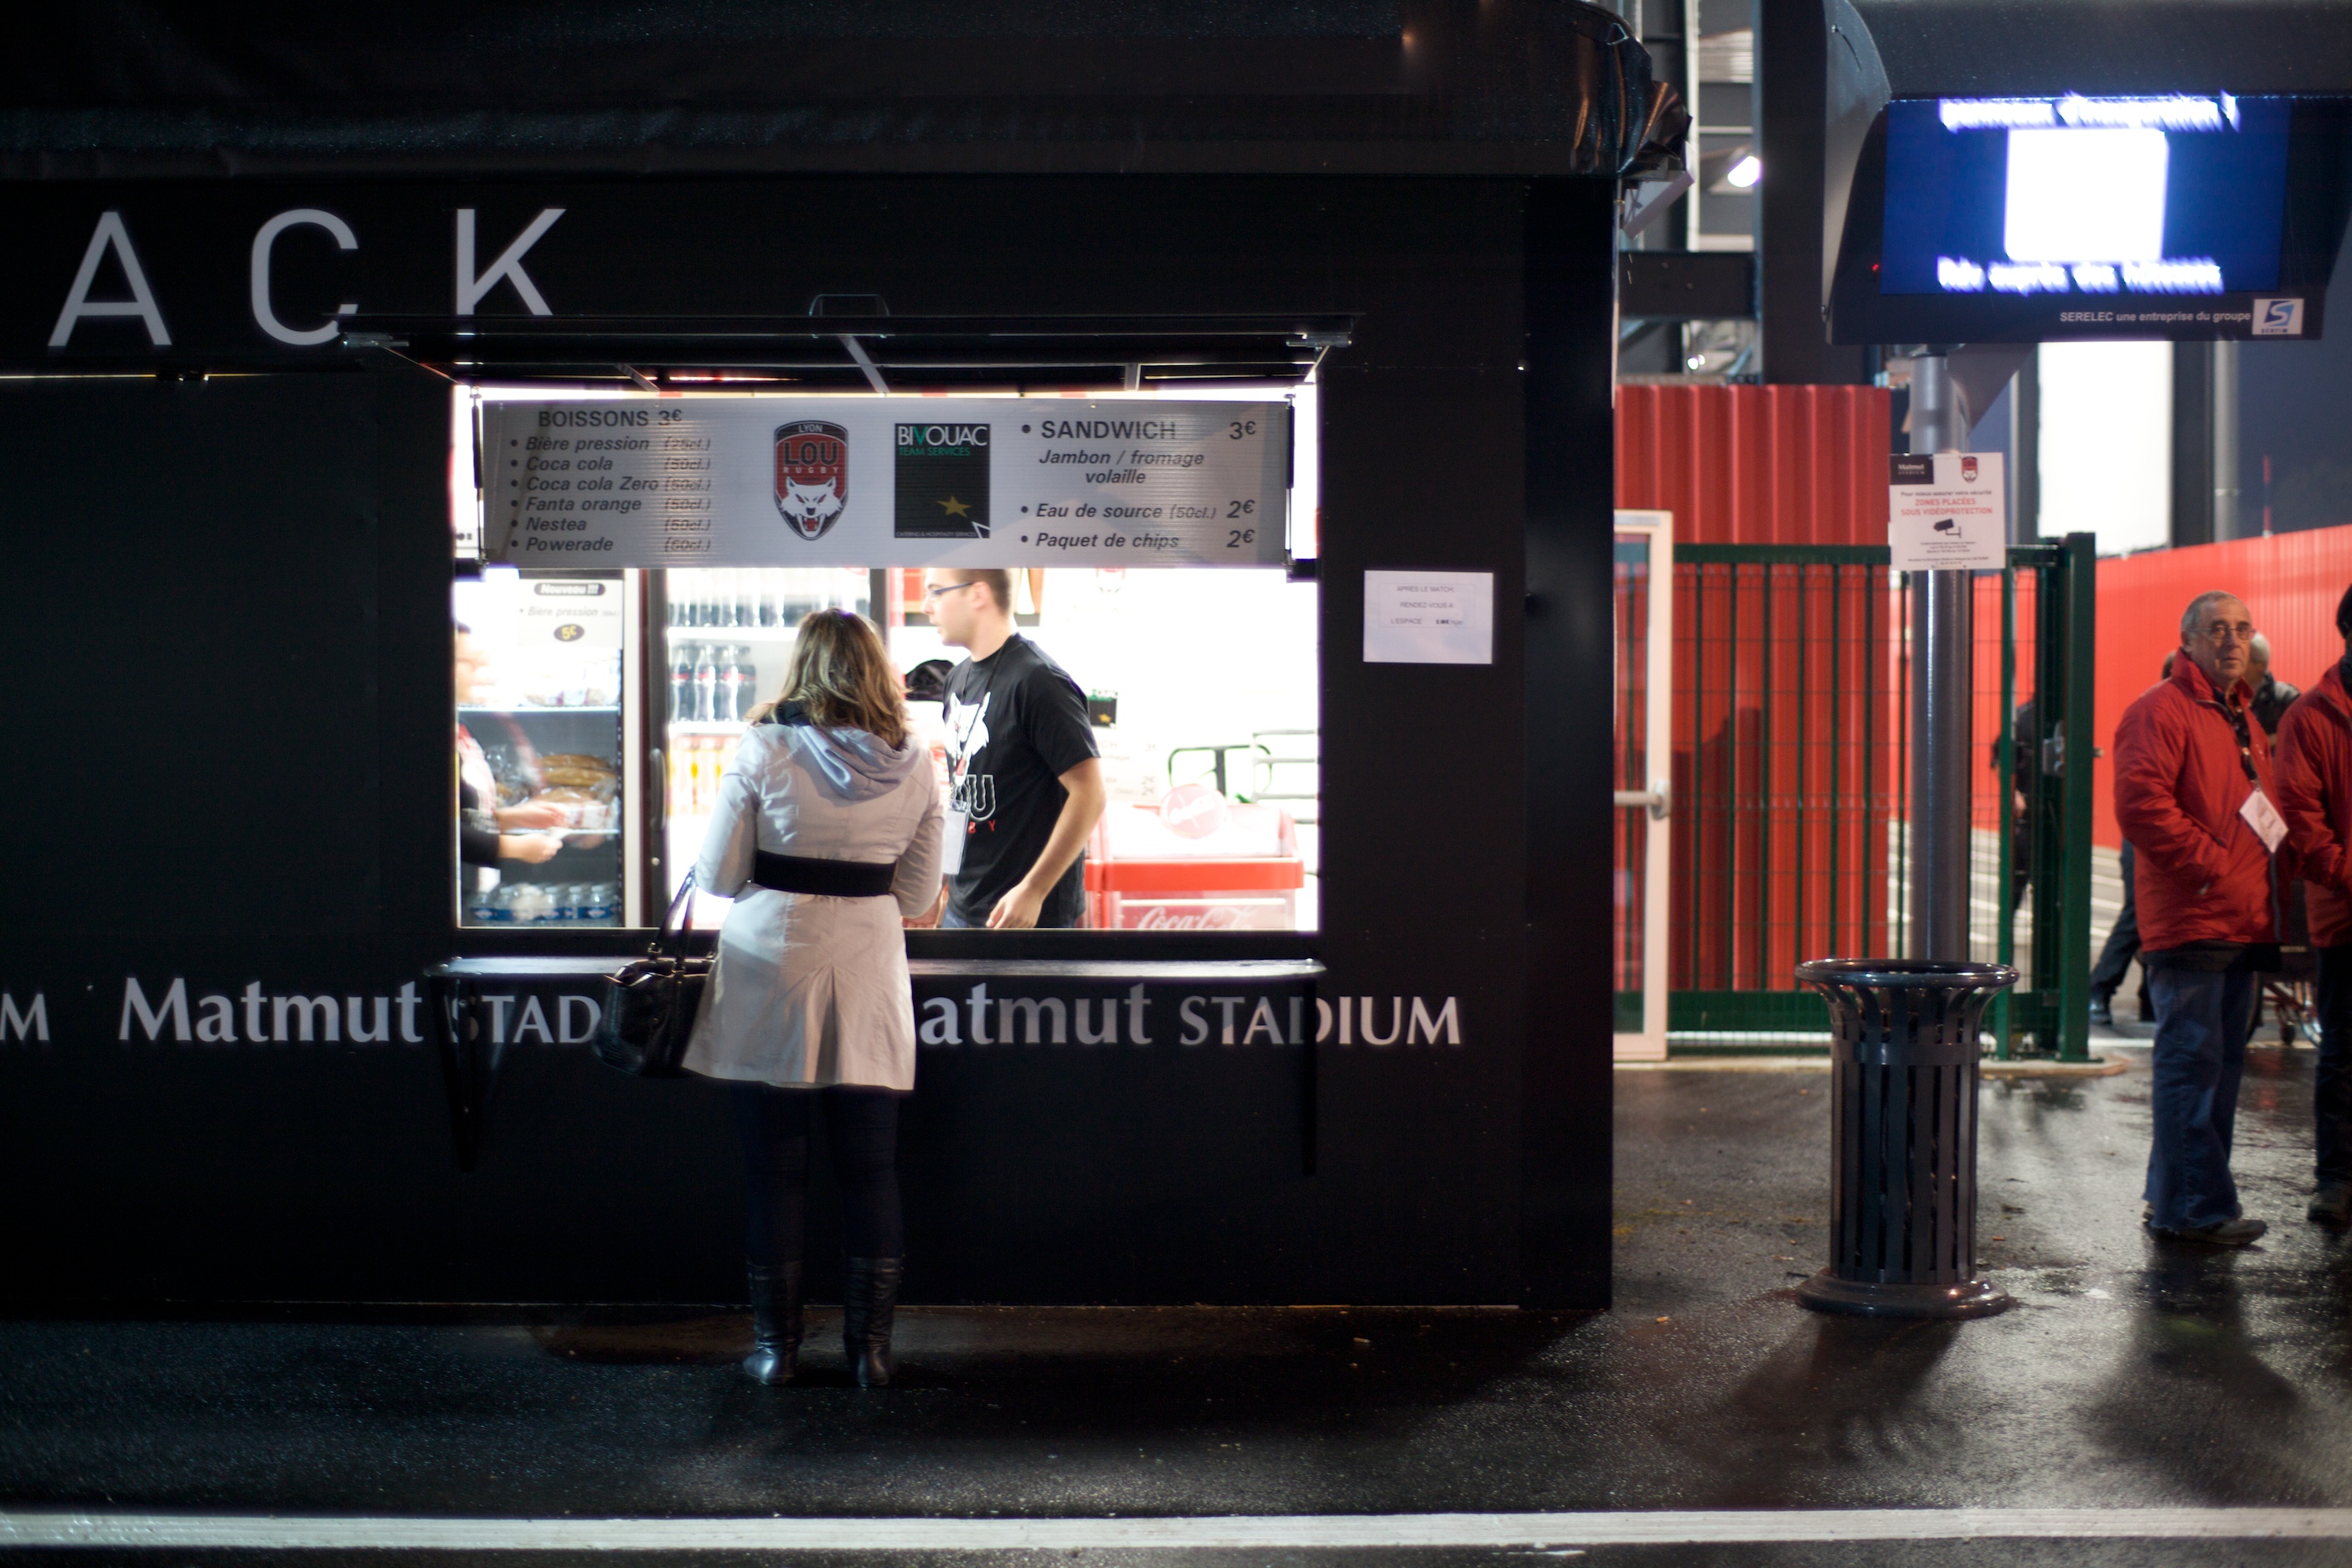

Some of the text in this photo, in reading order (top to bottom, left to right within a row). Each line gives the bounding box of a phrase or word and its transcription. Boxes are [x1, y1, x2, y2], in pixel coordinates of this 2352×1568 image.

[2060, 311, 2251, 323] SERELEC une entreprise du groupe
[538, 410, 683, 427] BOISSONS 3€
[797, 424, 823, 435] LYON
[897, 426, 988, 446] BIVOUAC
[1040, 420, 1256, 440] SANDWICH 3€
[526, 436, 570, 451] Bière
[575, 436, 649, 453] pression
[899, 447, 971, 456] TEAM SERVICES
[783, 441, 838, 466] LOU
[1039, 450, 1111, 465] Jambon
[1131, 450, 1204, 467] fromage
[526, 456, 570, 471] Coca
[576, 456, 613, 471] cola
[783, 467, 838, 475] RUGBY
[526, 477, 570, 491] Coca
[576, 476, 613, 491] cola
[620, 477, 659, 491] Zero
[1086, 469, 1146, 484] volaille
[526, 497, 575, 511] Fanta
[580, 500, 642, 514] orange
[1942, 497, 1976, 505] PLACÉES
[1036, 499, 1255, 520] Eau de source (50cl.) 2€
[1922, 506, 1993, 515] VIDÉOPROTECTION
[526, 518, 586, 531] Nestea
[526, 538, 614, 552] Powerade
[1036, 529, 1255, 550] Paquet de chips 2€
[540, 584, 586, 595] Nouveau
[528, 606, 553, 616] Bière
[555, 606, 598, 618] pression
[119, 977, 424, 1044] Matmut
[921, 982, 1461, 1045] atmut STADIUM
